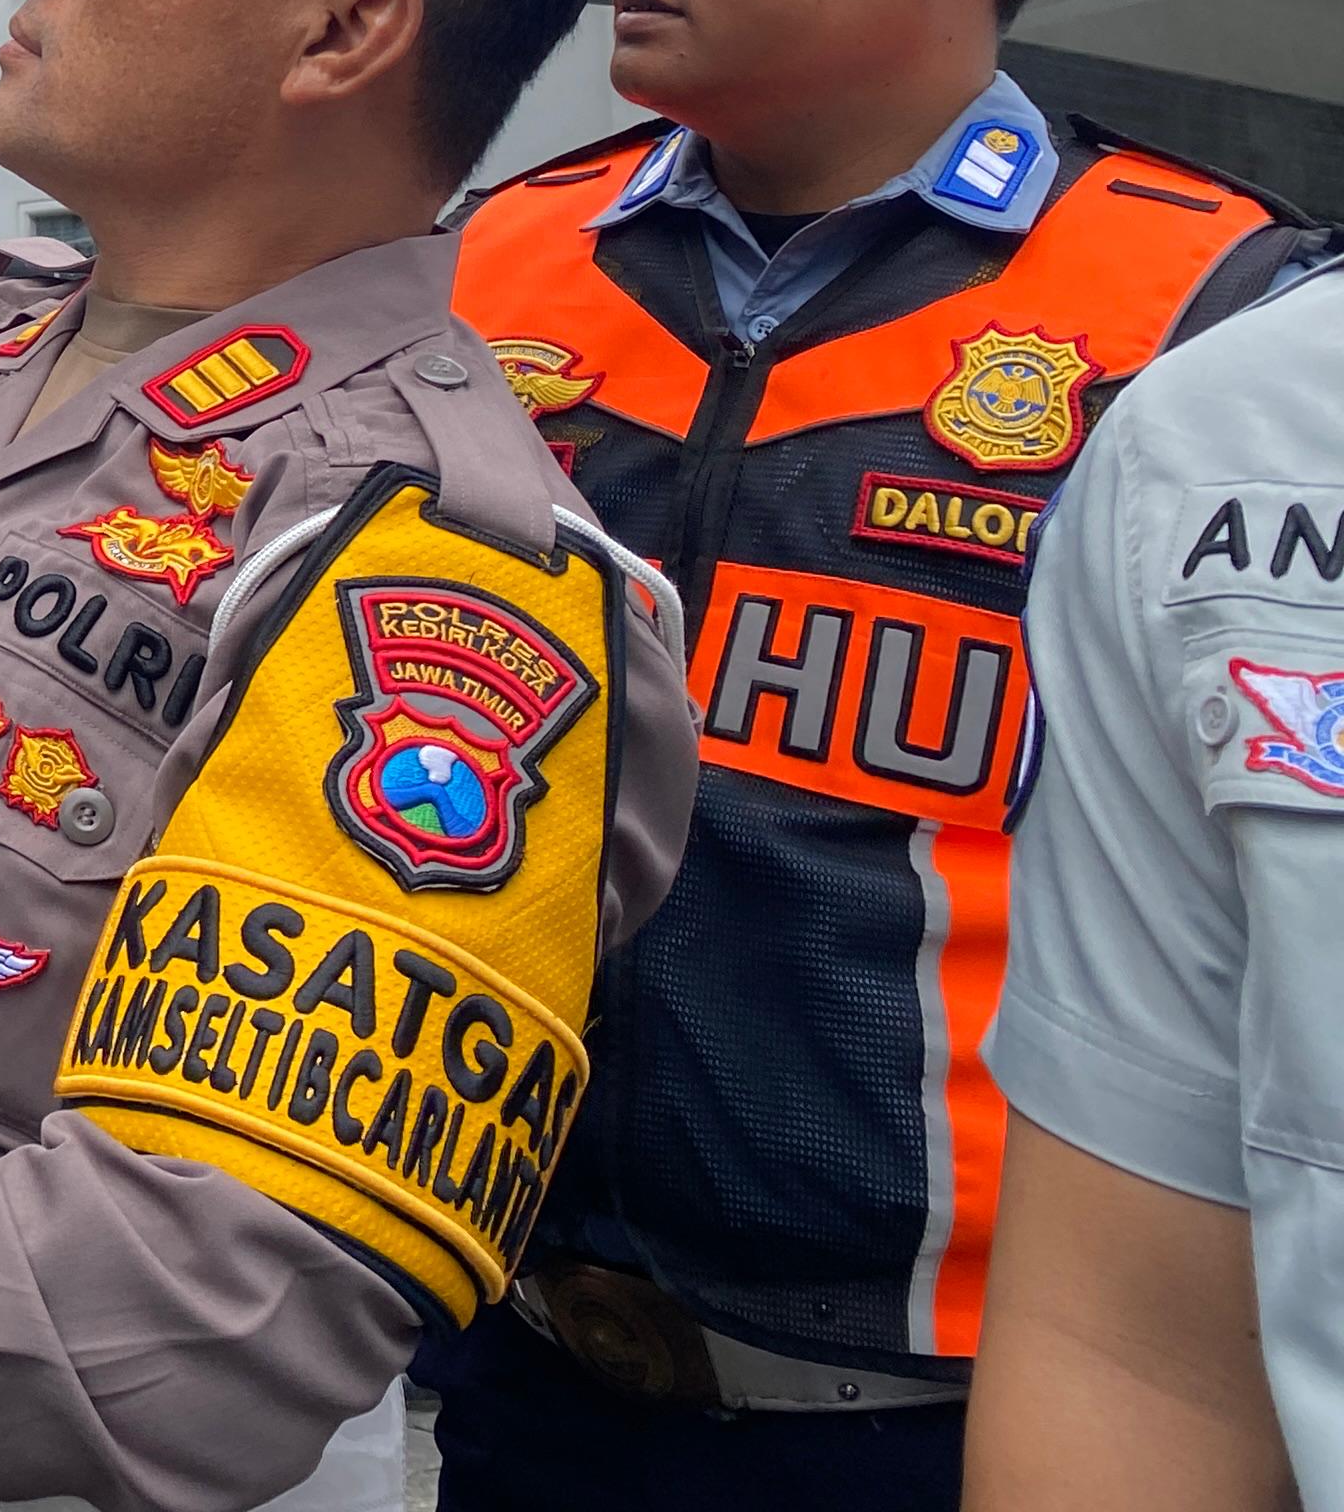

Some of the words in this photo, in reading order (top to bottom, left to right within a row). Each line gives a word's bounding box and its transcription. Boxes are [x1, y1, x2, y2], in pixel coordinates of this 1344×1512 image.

[379, 601, 559, 685] POLRES
[381, 619, 480, 654] KEDIRI
[480, 638, 550, 697] KOTA
[391, 662, 457, 691] JAWA
[462, 677, 526, 732] TIMUR
[105, 879, 577, 1171] KASATGAS
